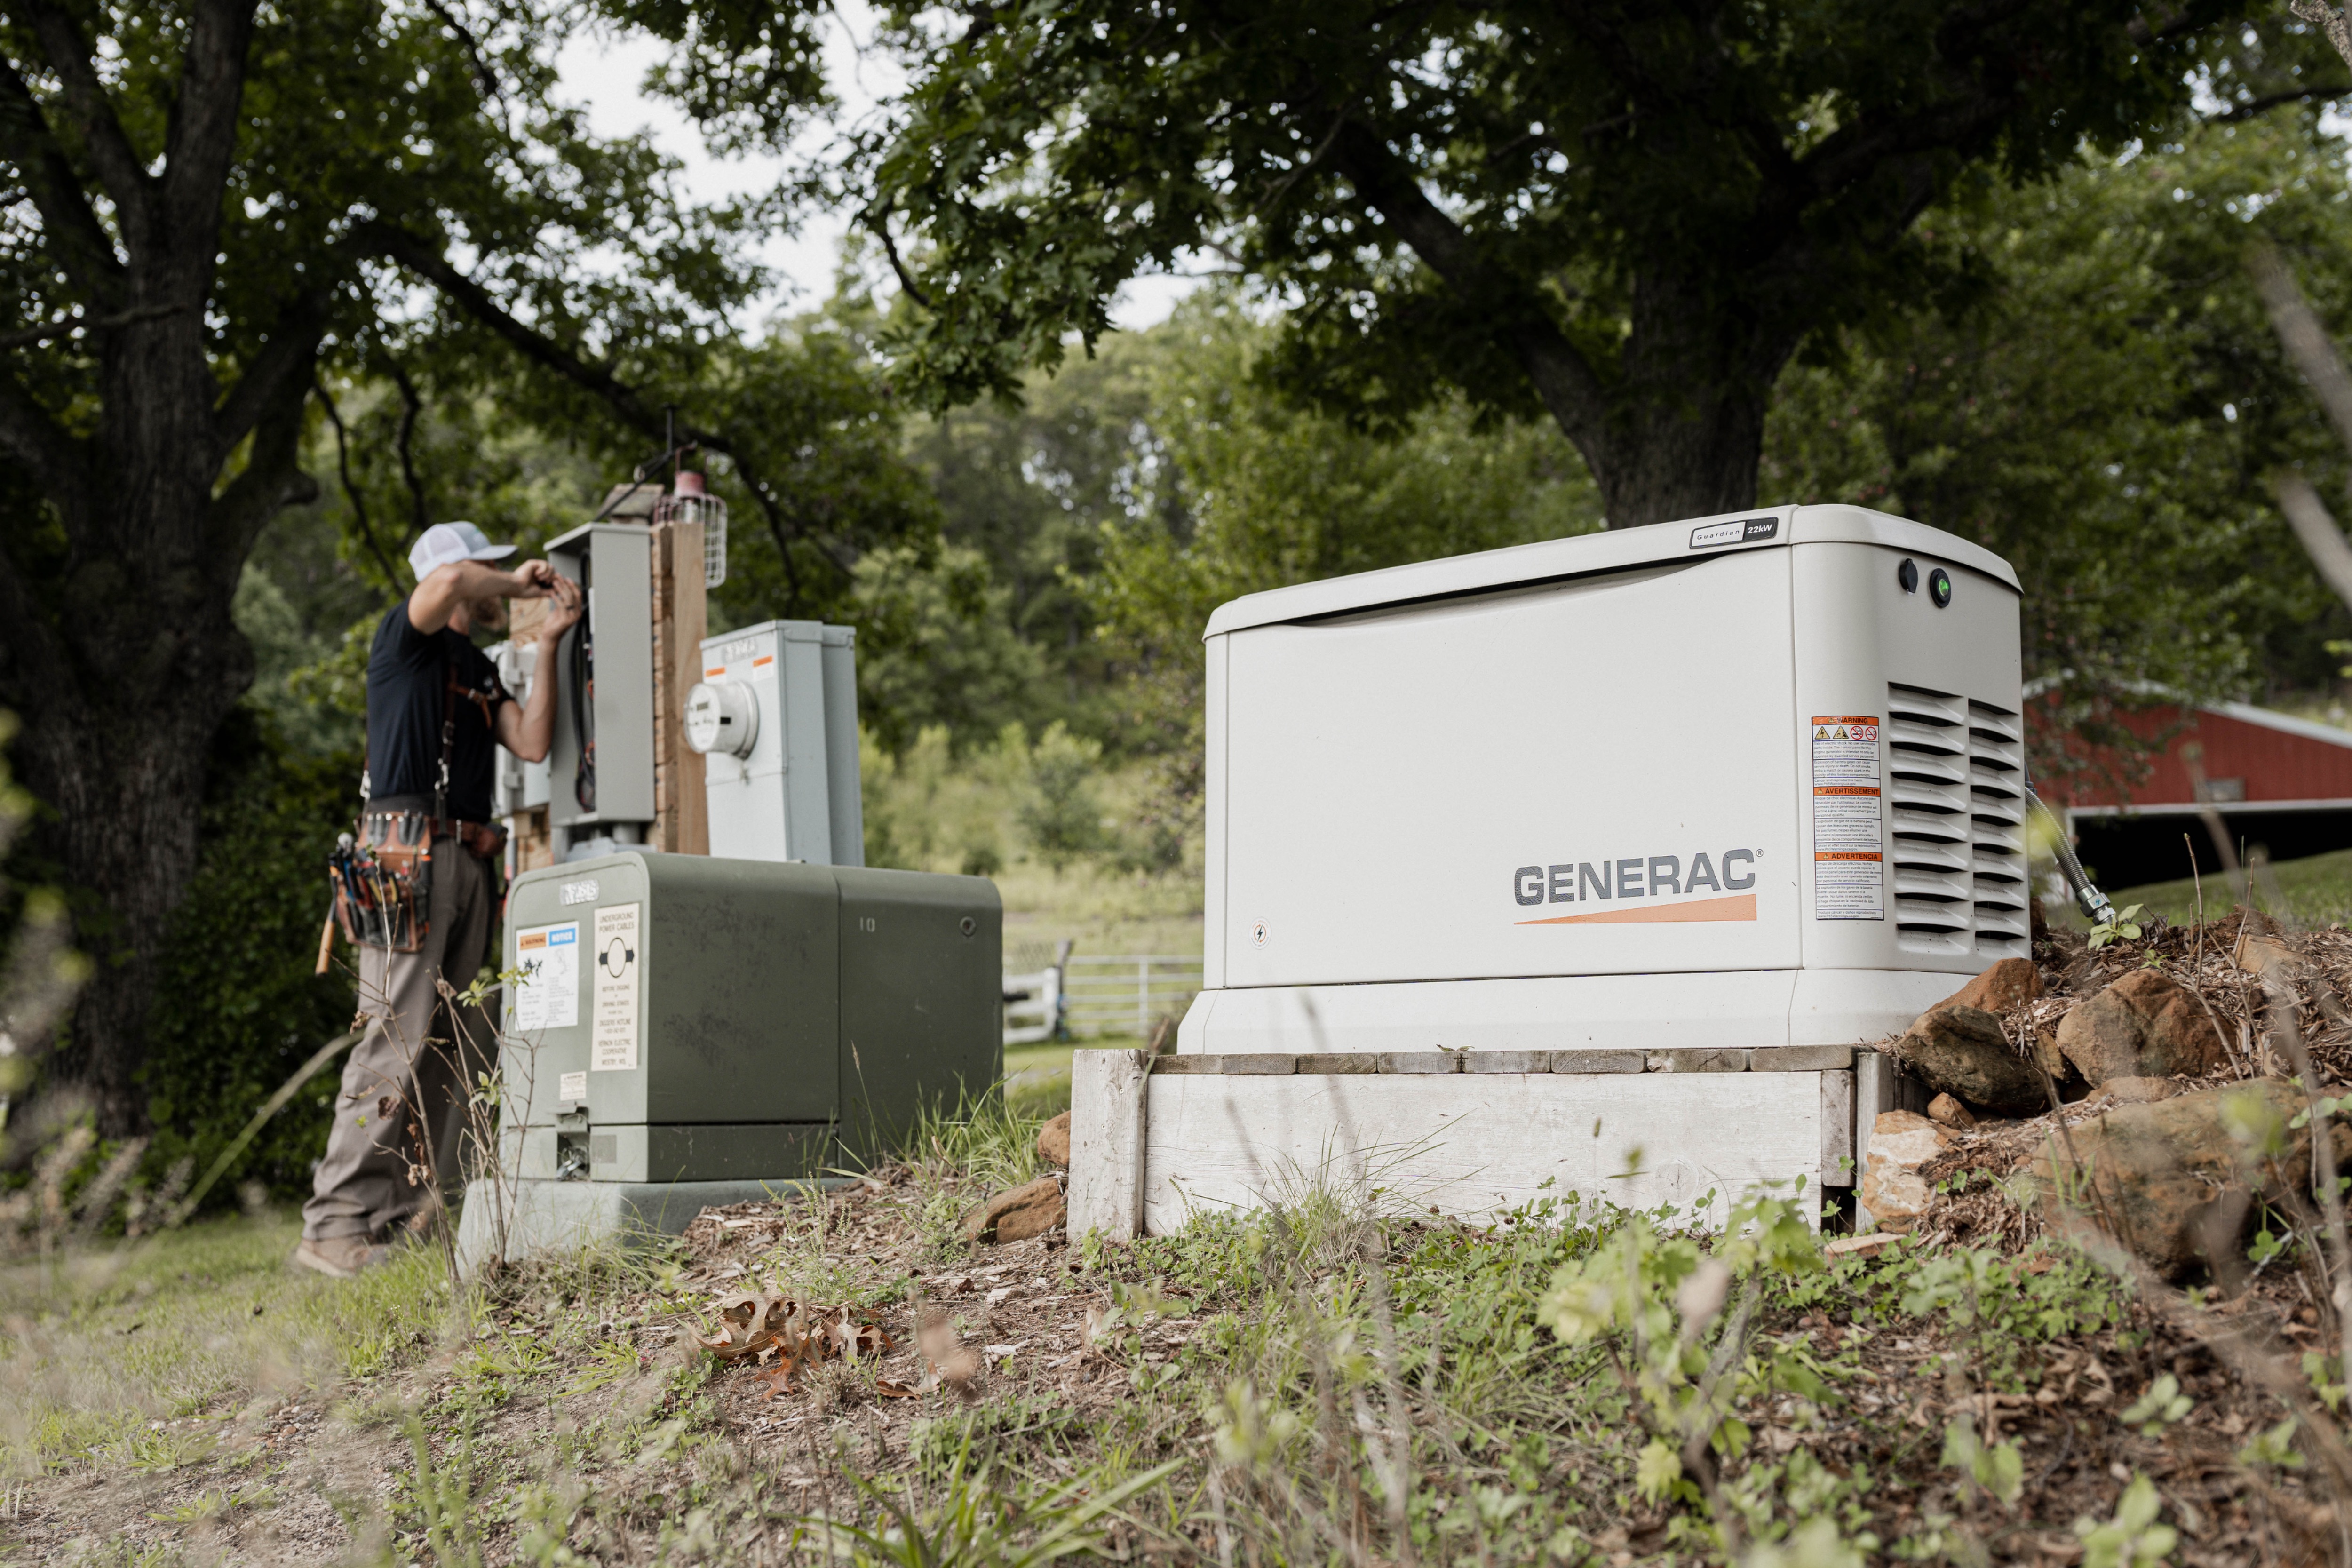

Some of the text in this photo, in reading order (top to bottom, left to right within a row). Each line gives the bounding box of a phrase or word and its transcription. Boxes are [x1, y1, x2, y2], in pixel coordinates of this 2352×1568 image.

[1697, 524, 1773, 540] Guardian 22kW
[1514, 849, 1755, 906] GENERAC
[599, 911, 634, 923] UNDERGROUND
[599, 921, 634, 932] POWER CABLES
[860, 917, 875, 932] 10
[551, 931, 573, 942] NOTICE
